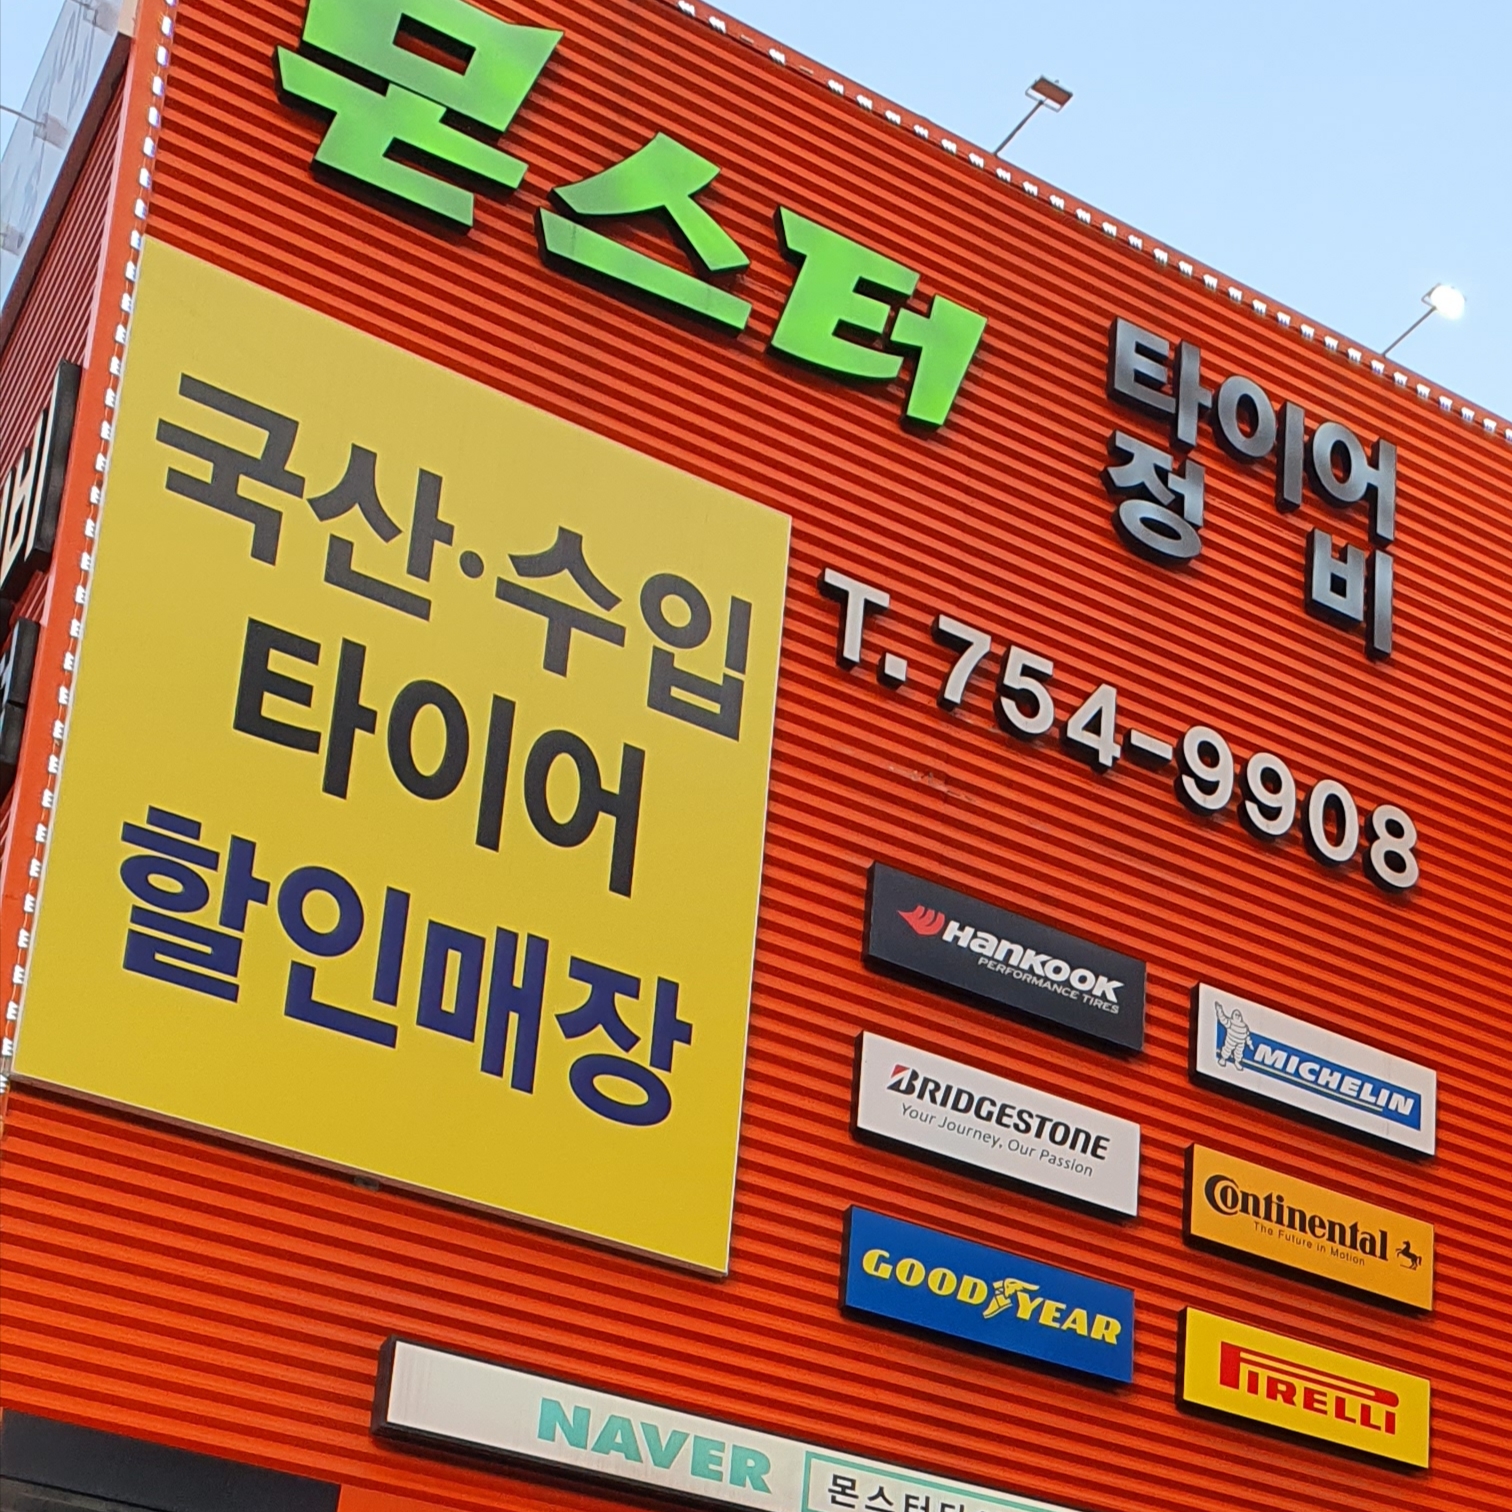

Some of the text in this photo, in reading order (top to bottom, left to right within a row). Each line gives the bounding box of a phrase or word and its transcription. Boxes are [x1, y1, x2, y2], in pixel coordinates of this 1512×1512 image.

[273, 0, 988, 426] 몬스터
[1107, 316, 1397, 547] 타이어
[233, 617, 646, 897] 타이어
[819, 567, 1418, 889] T.754-9908
[119, 805, 693, 1127] 할인매장
[978, 956, 1119, 1014] PERFORMANCE TIRES
[886, 1064, 1110, 1160] BRIDGESTONE
[1254, 1043, 1414, 1116] MICHELIN
[902, 1103, 1093, 1177] Your Journey, Our Passion
[1204, 1174, 1389, 1262] Continental
[1254, 1221, 1365, 1266] The Future in Motion
[1220, 1340, 1399, 1435] PIRELLI
[537, 1397, 772, 1494] NAVER
